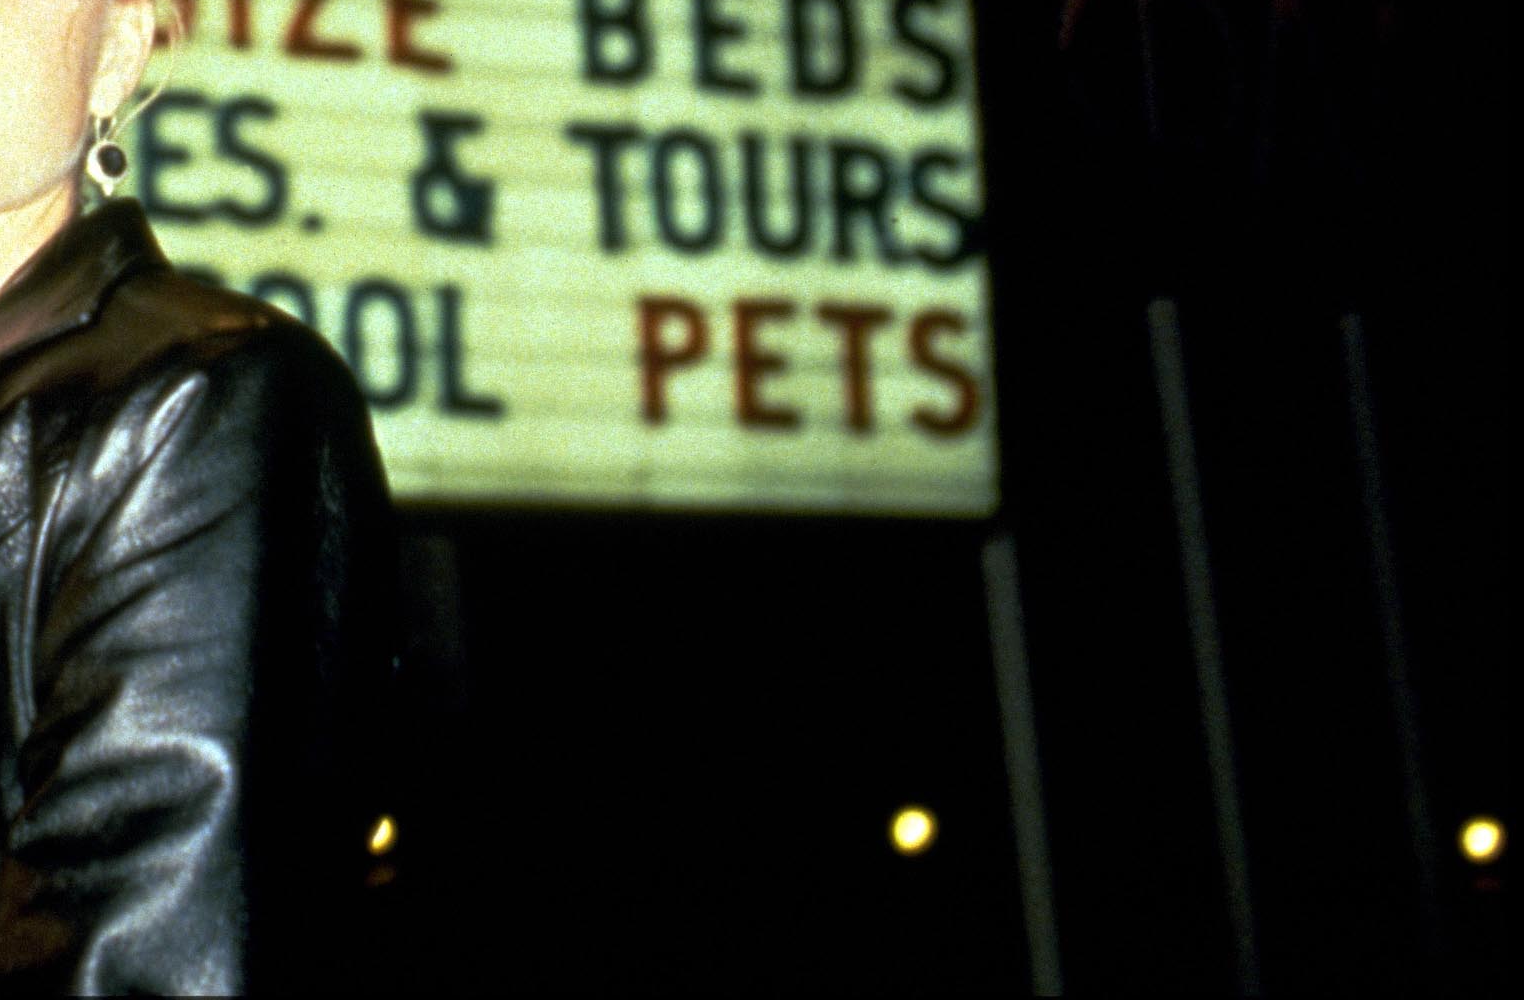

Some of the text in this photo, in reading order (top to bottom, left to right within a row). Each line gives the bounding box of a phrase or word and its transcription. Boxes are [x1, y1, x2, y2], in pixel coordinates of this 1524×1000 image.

[410, 110, 496, 248] &
[564, 121, 986, 273] TOURS
[634, 294, 983, 441] PETS
